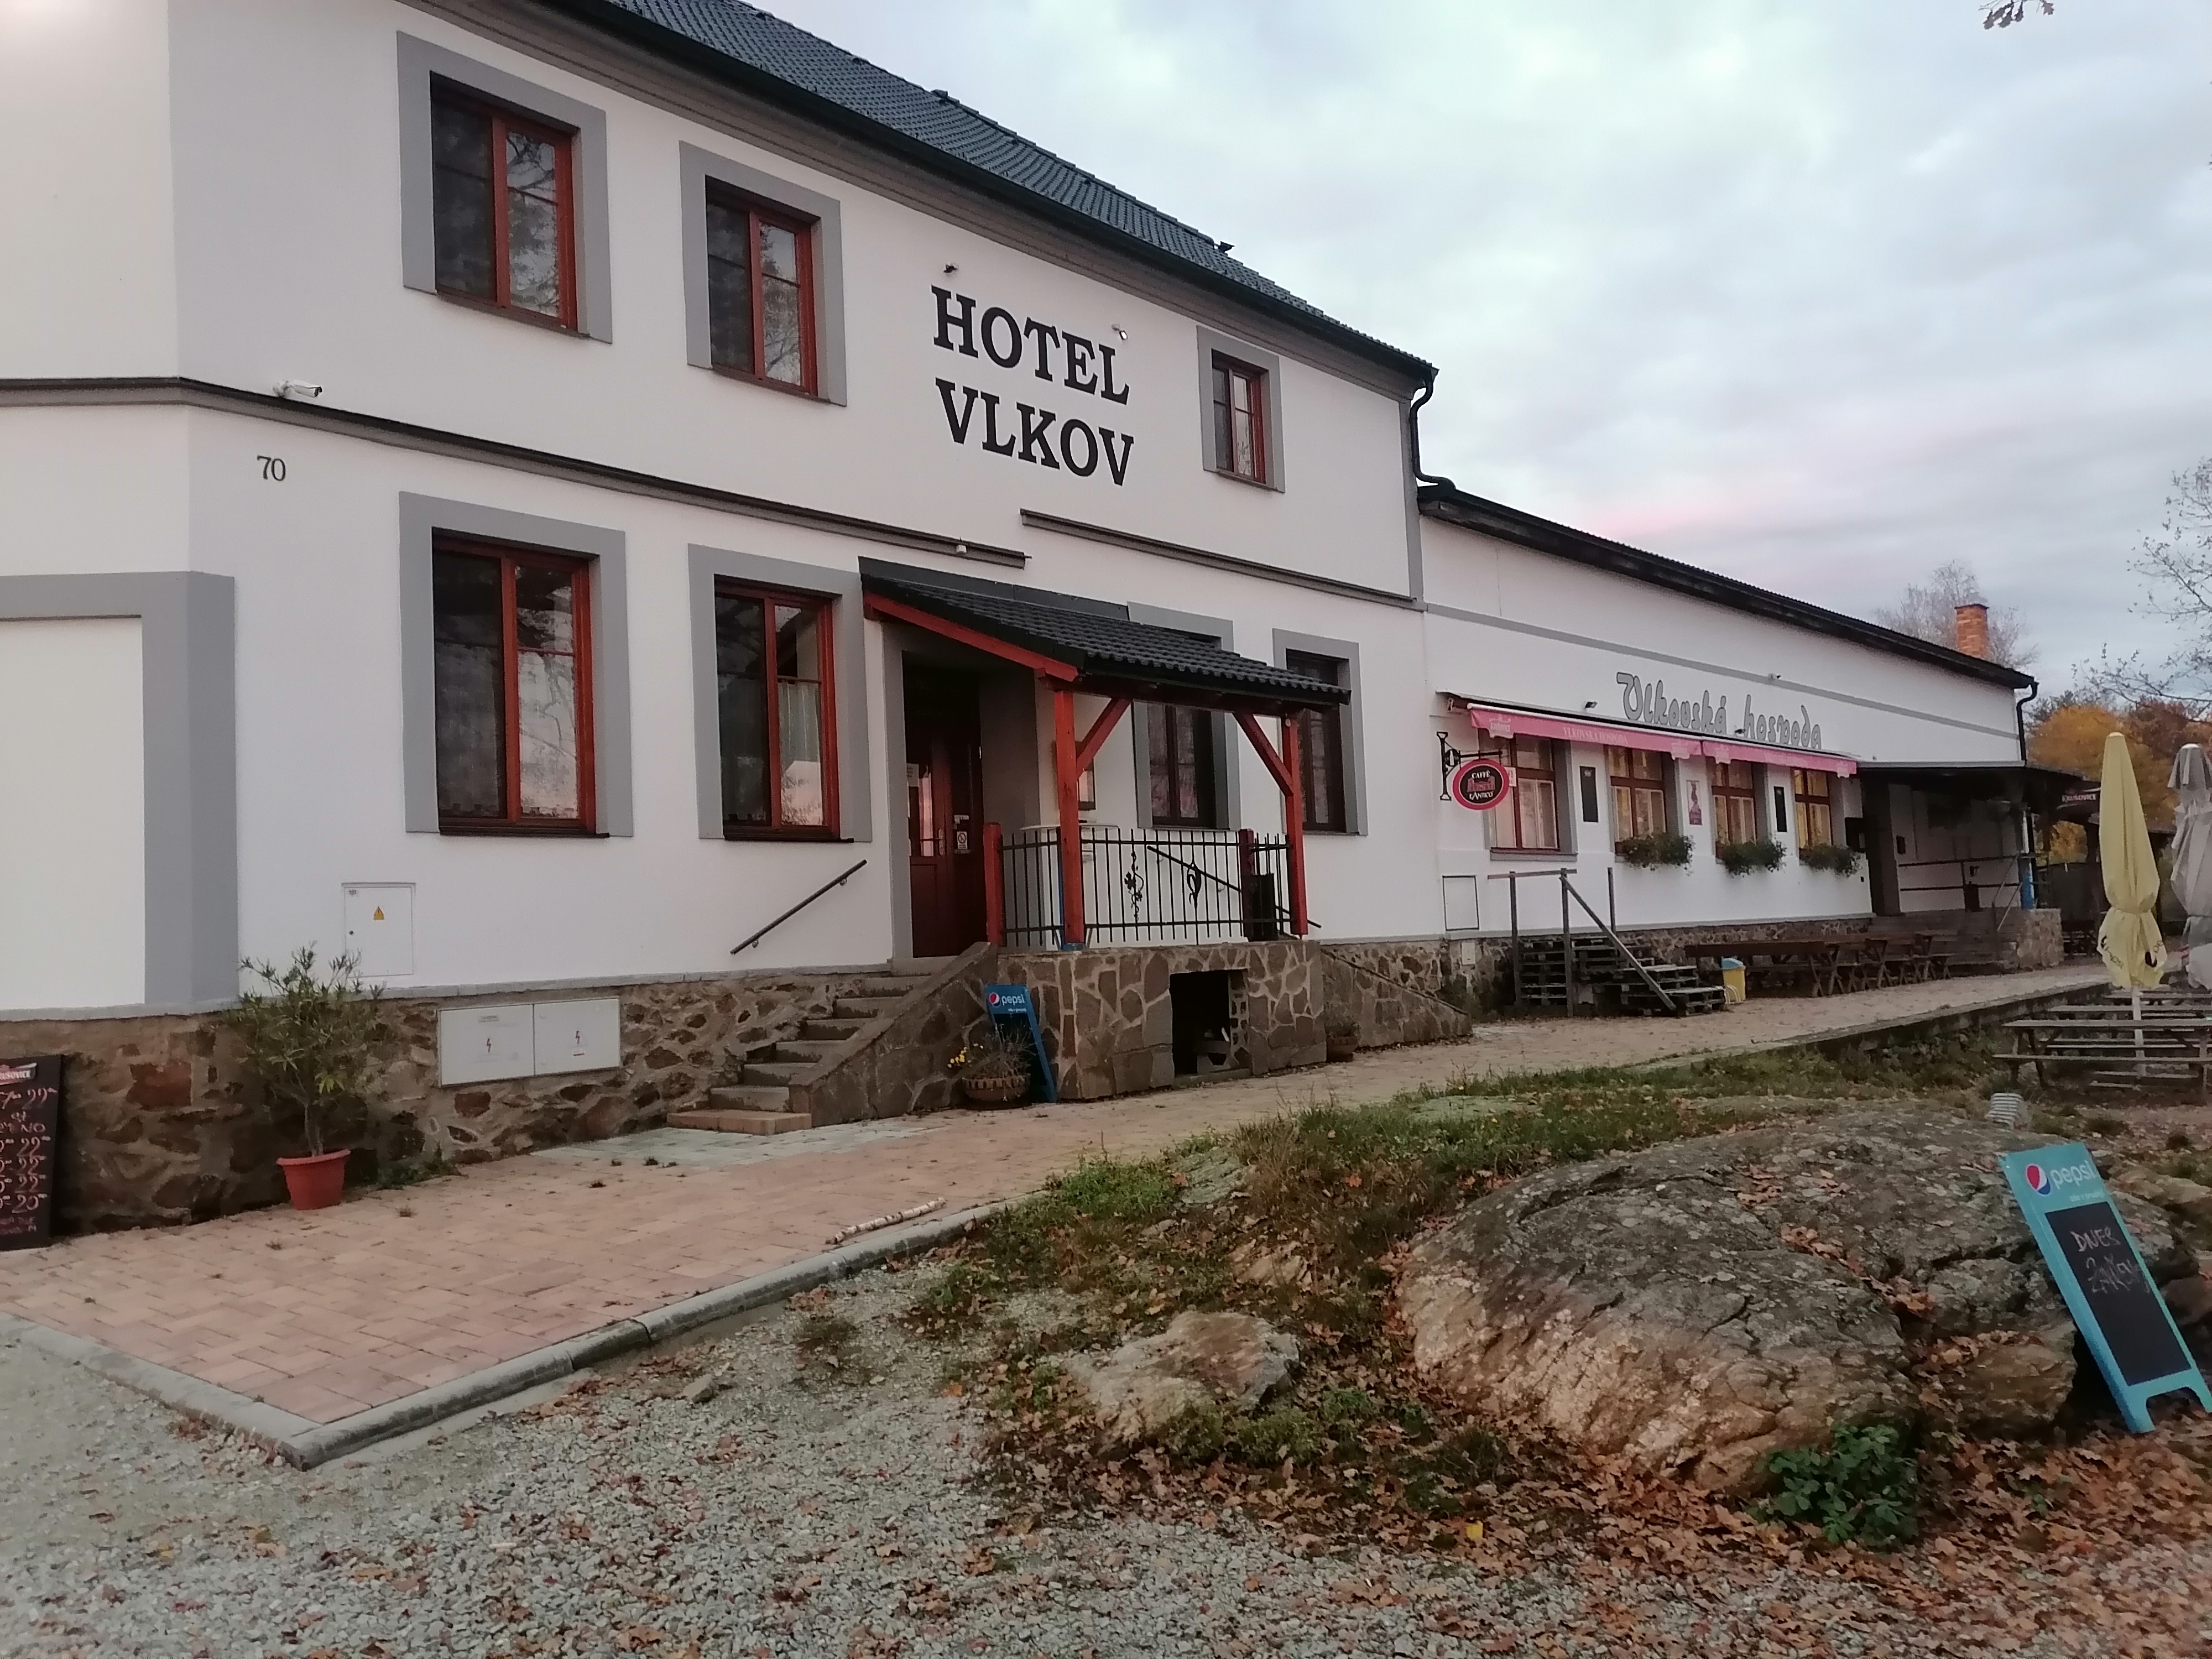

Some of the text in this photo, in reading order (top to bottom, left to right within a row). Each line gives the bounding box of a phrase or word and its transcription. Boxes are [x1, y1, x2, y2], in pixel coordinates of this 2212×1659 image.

[931, 284, 1130, 405] HOTEL
[935, 377, 1134, 487] VLKOV
[257, 455, 286, 482] 70
[1744, 694, 1822, 750] hospoda
[1001, 994, 1026, 1006] pepsi
[2050, 1160, 2096, 1190] pepsi
